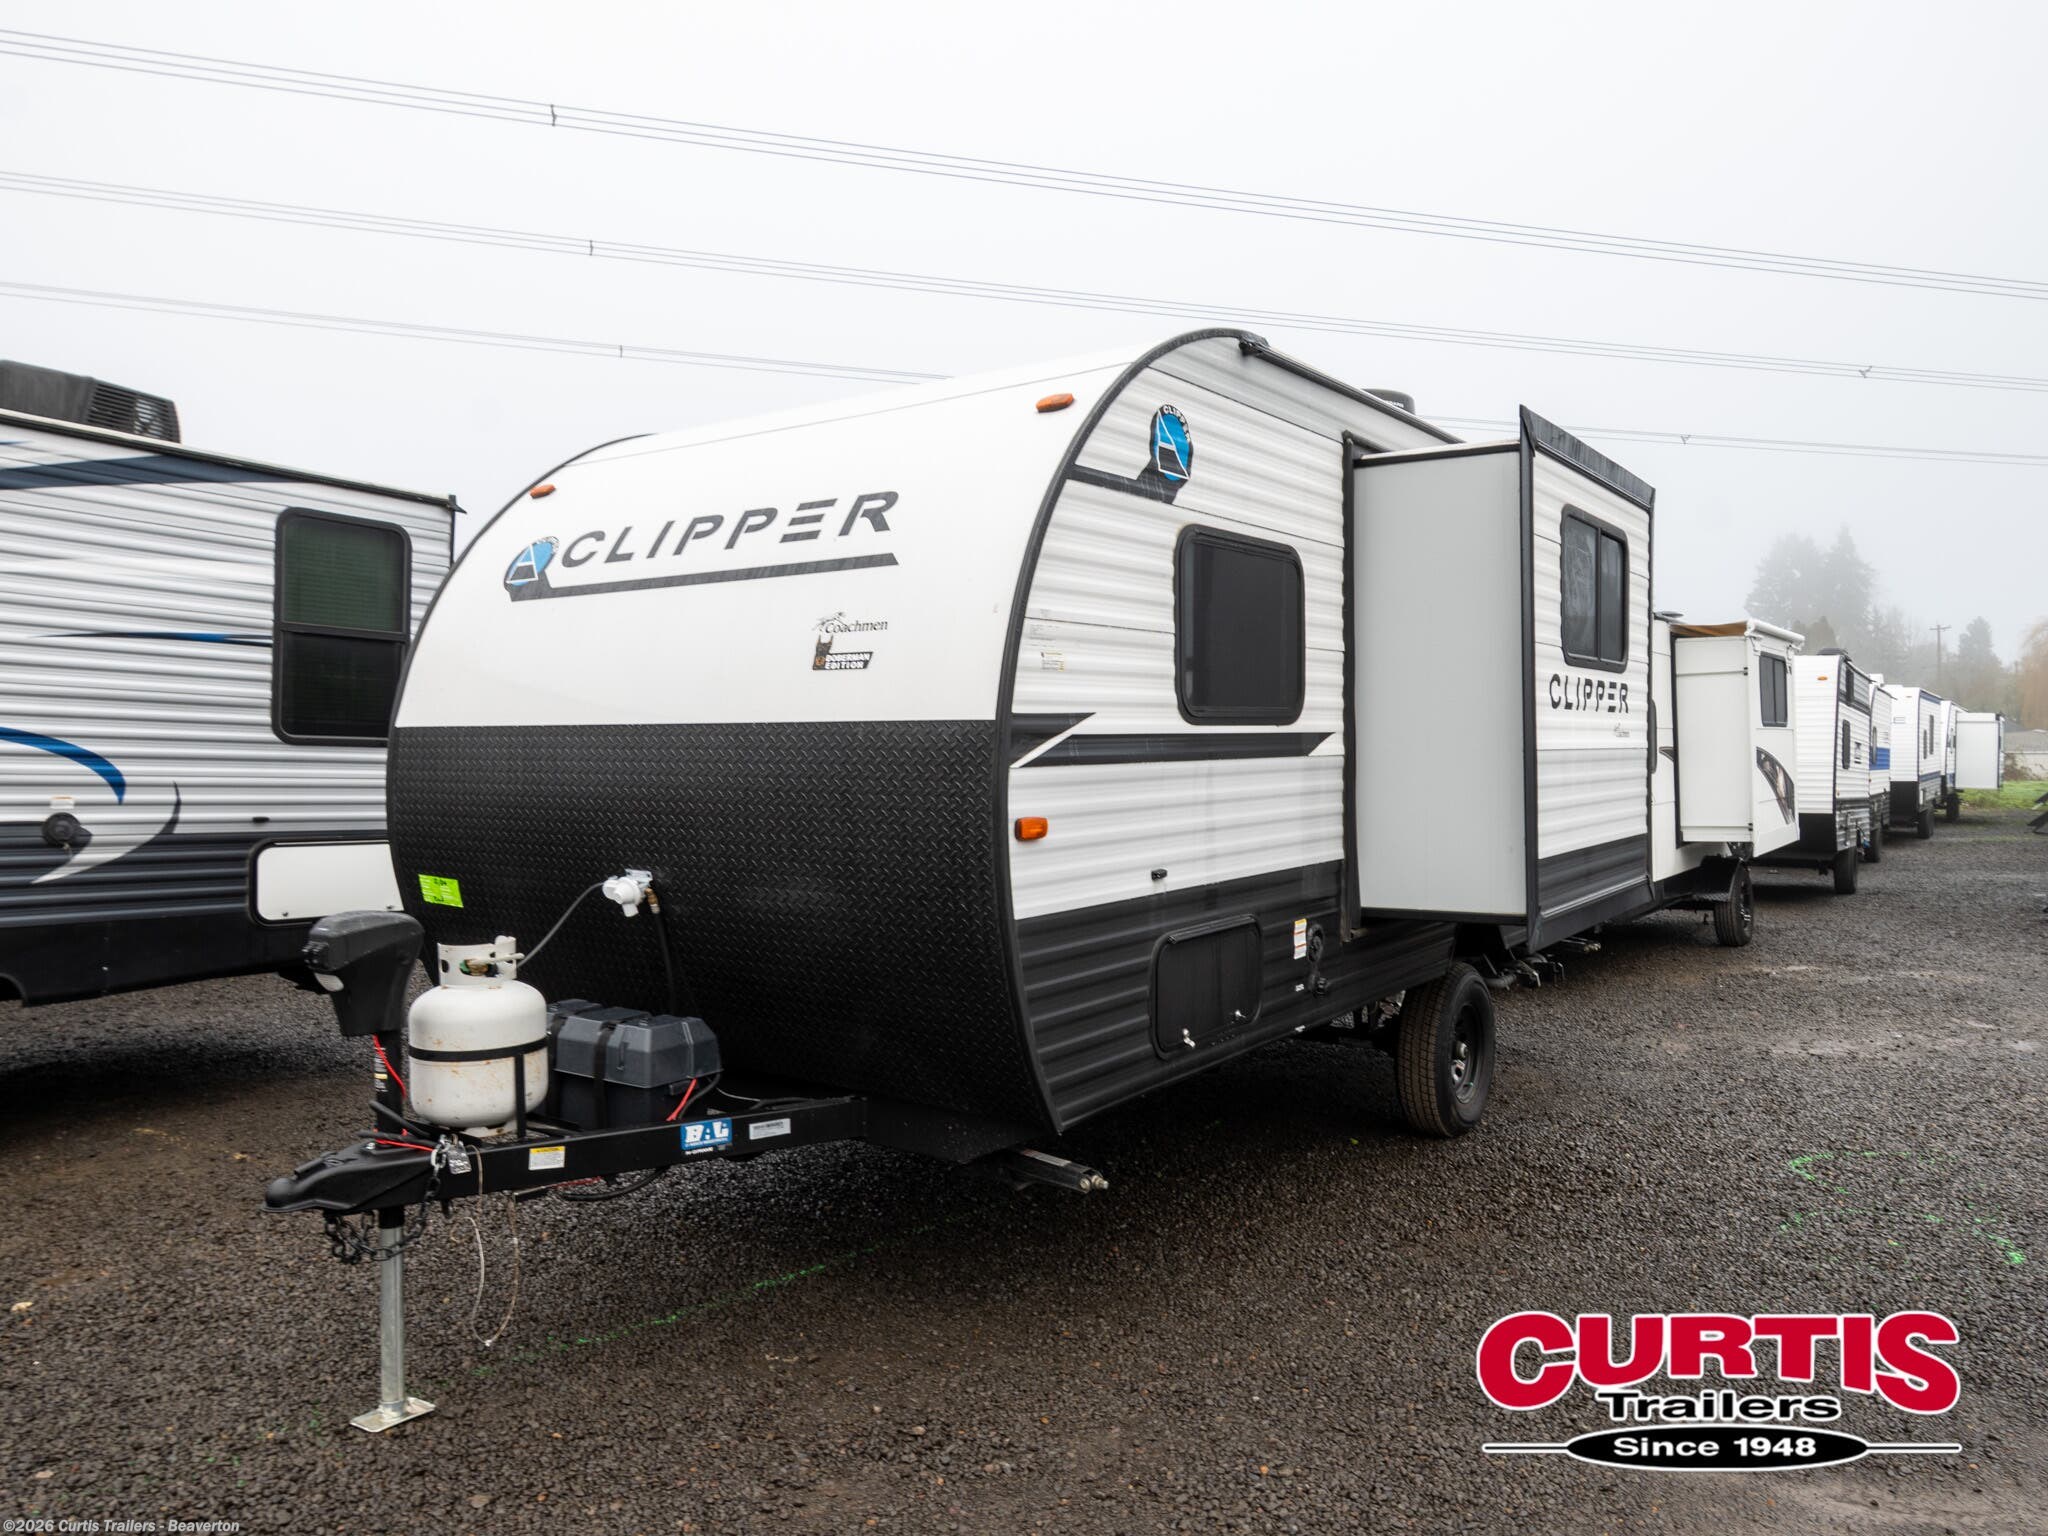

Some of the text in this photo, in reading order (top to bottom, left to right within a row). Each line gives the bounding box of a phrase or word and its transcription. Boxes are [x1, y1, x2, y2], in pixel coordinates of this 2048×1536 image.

[561, 491, 899, 568] CLIPPER
[825, 620, 888, 633] Coachmen
[825, 660, 865, 670] EDITION
[1549, 674, 1629, 713] CLIPPER
